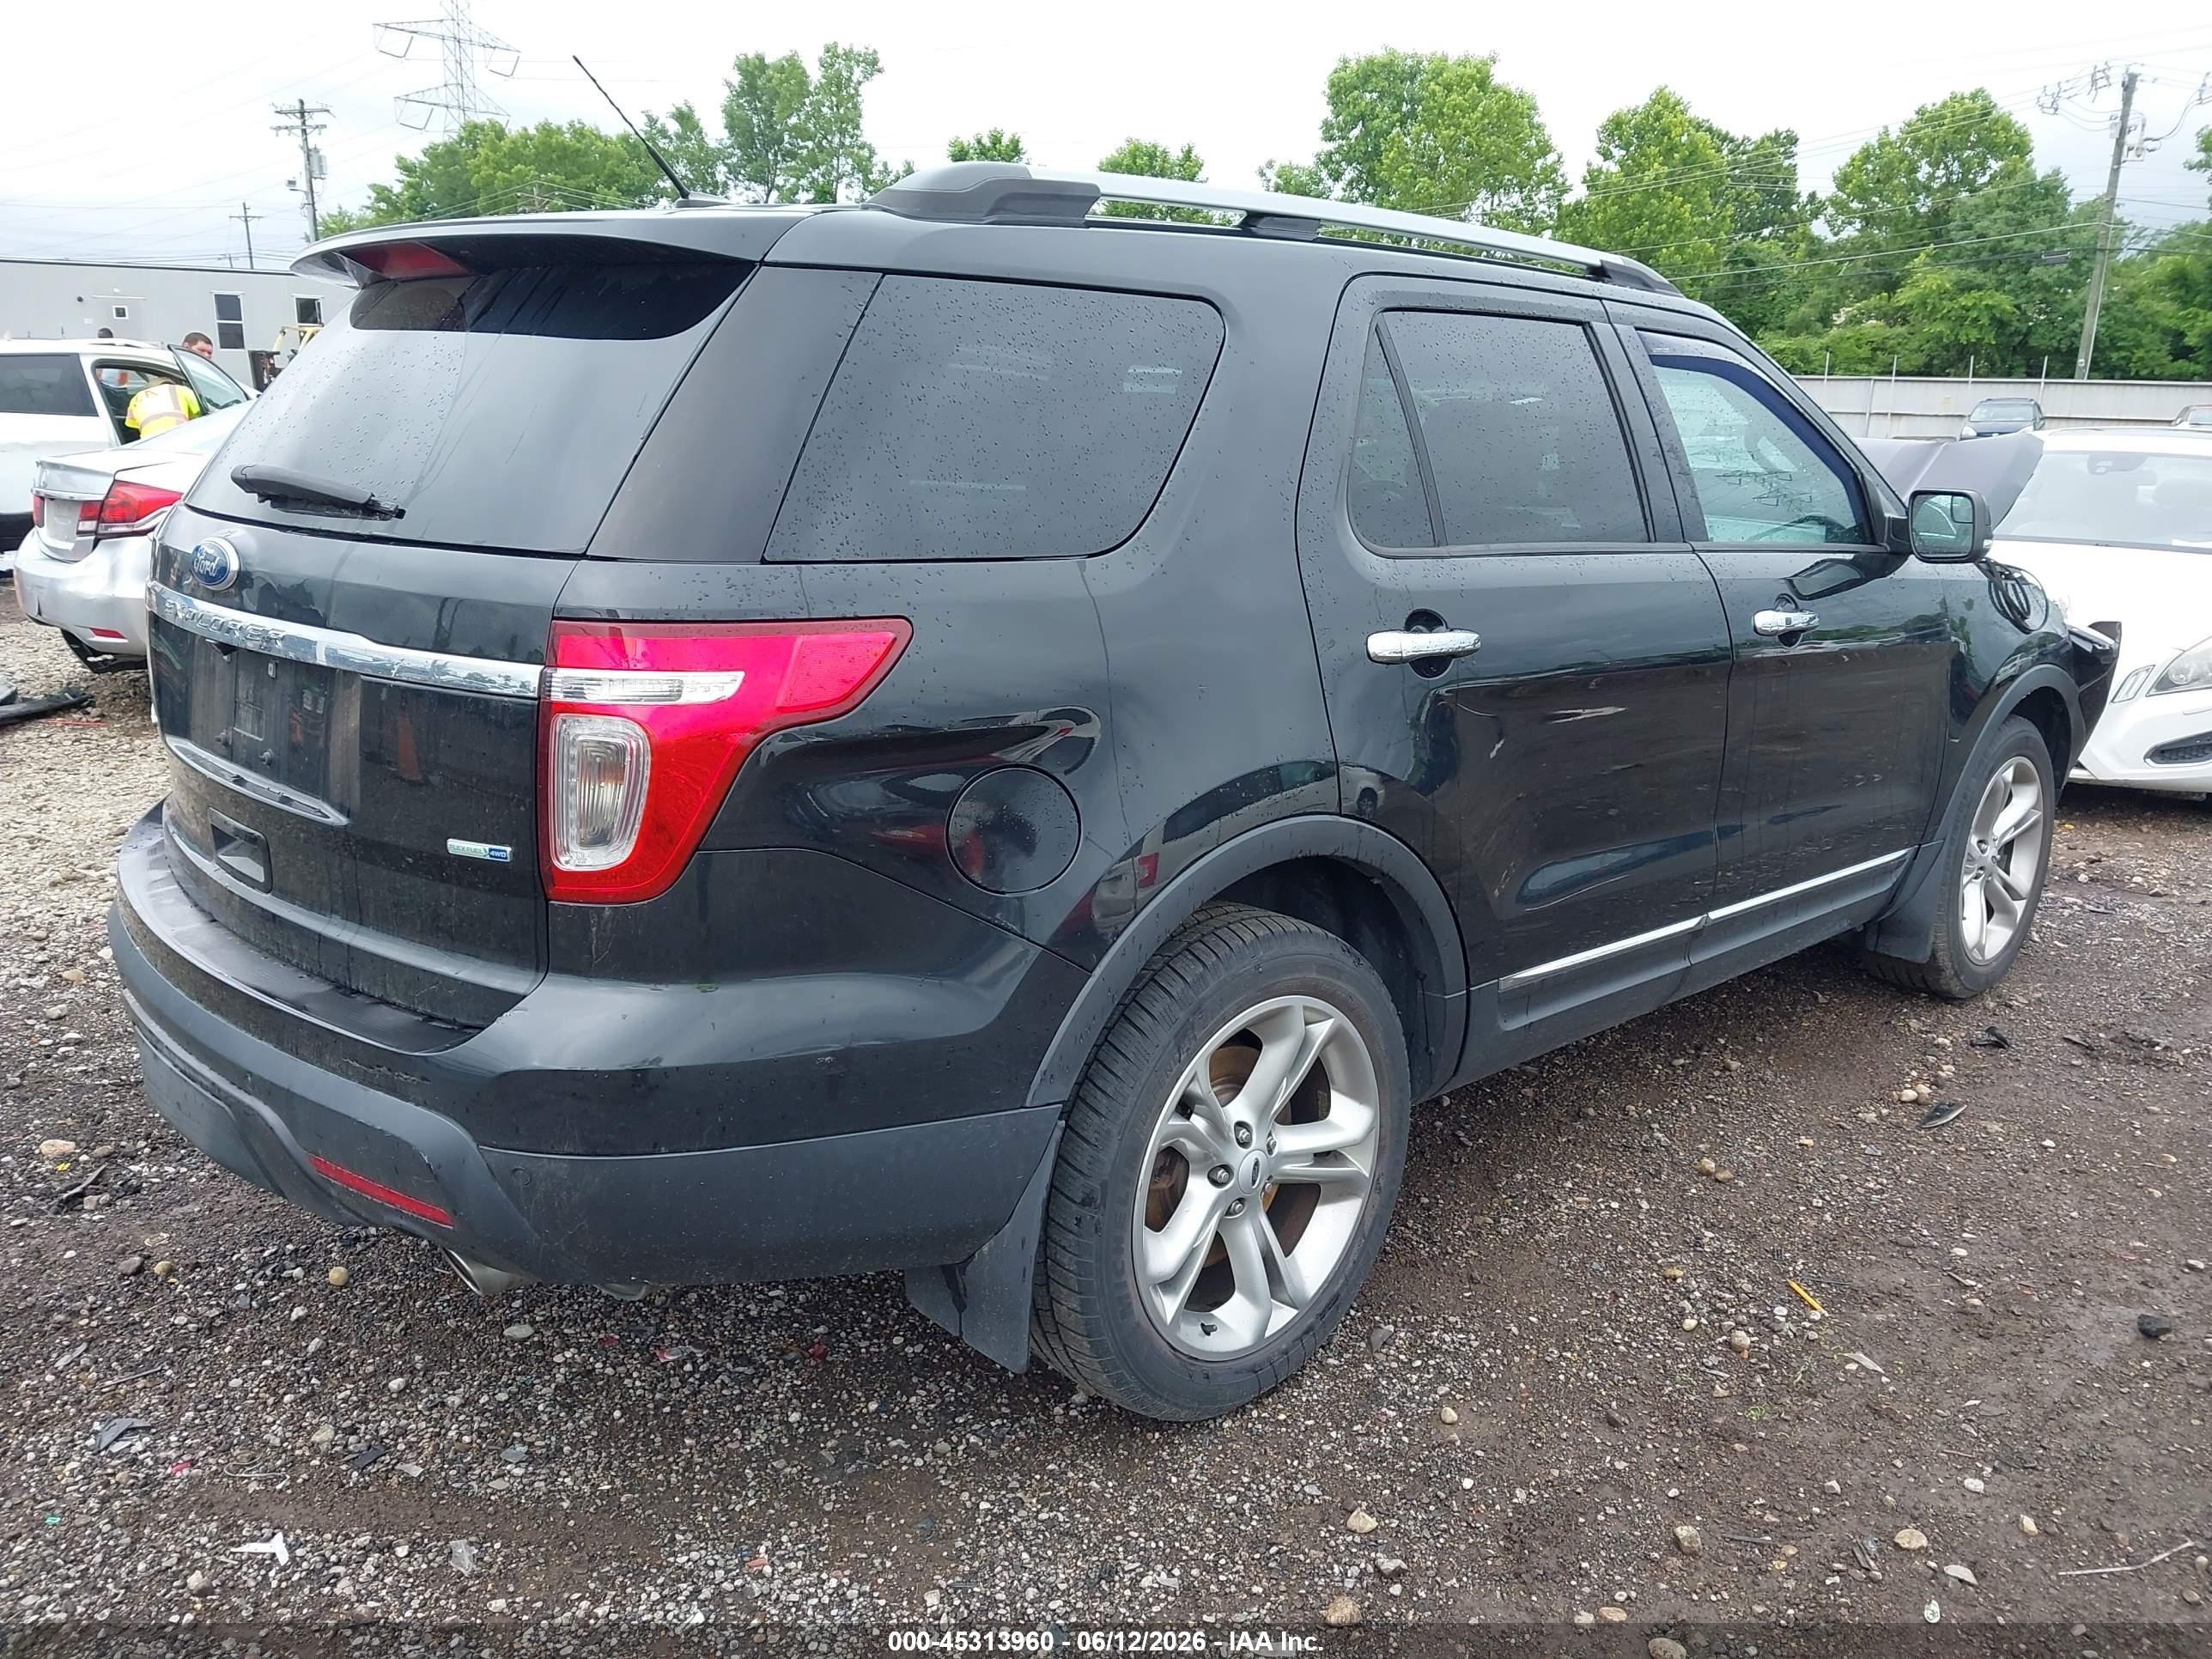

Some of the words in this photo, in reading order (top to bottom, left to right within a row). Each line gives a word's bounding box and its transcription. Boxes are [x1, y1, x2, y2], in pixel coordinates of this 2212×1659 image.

[193, 544, 222, 578] Ford
[163, 598, 286, 648] EXPLORER
[466, 847, 483, 855] FUEL
